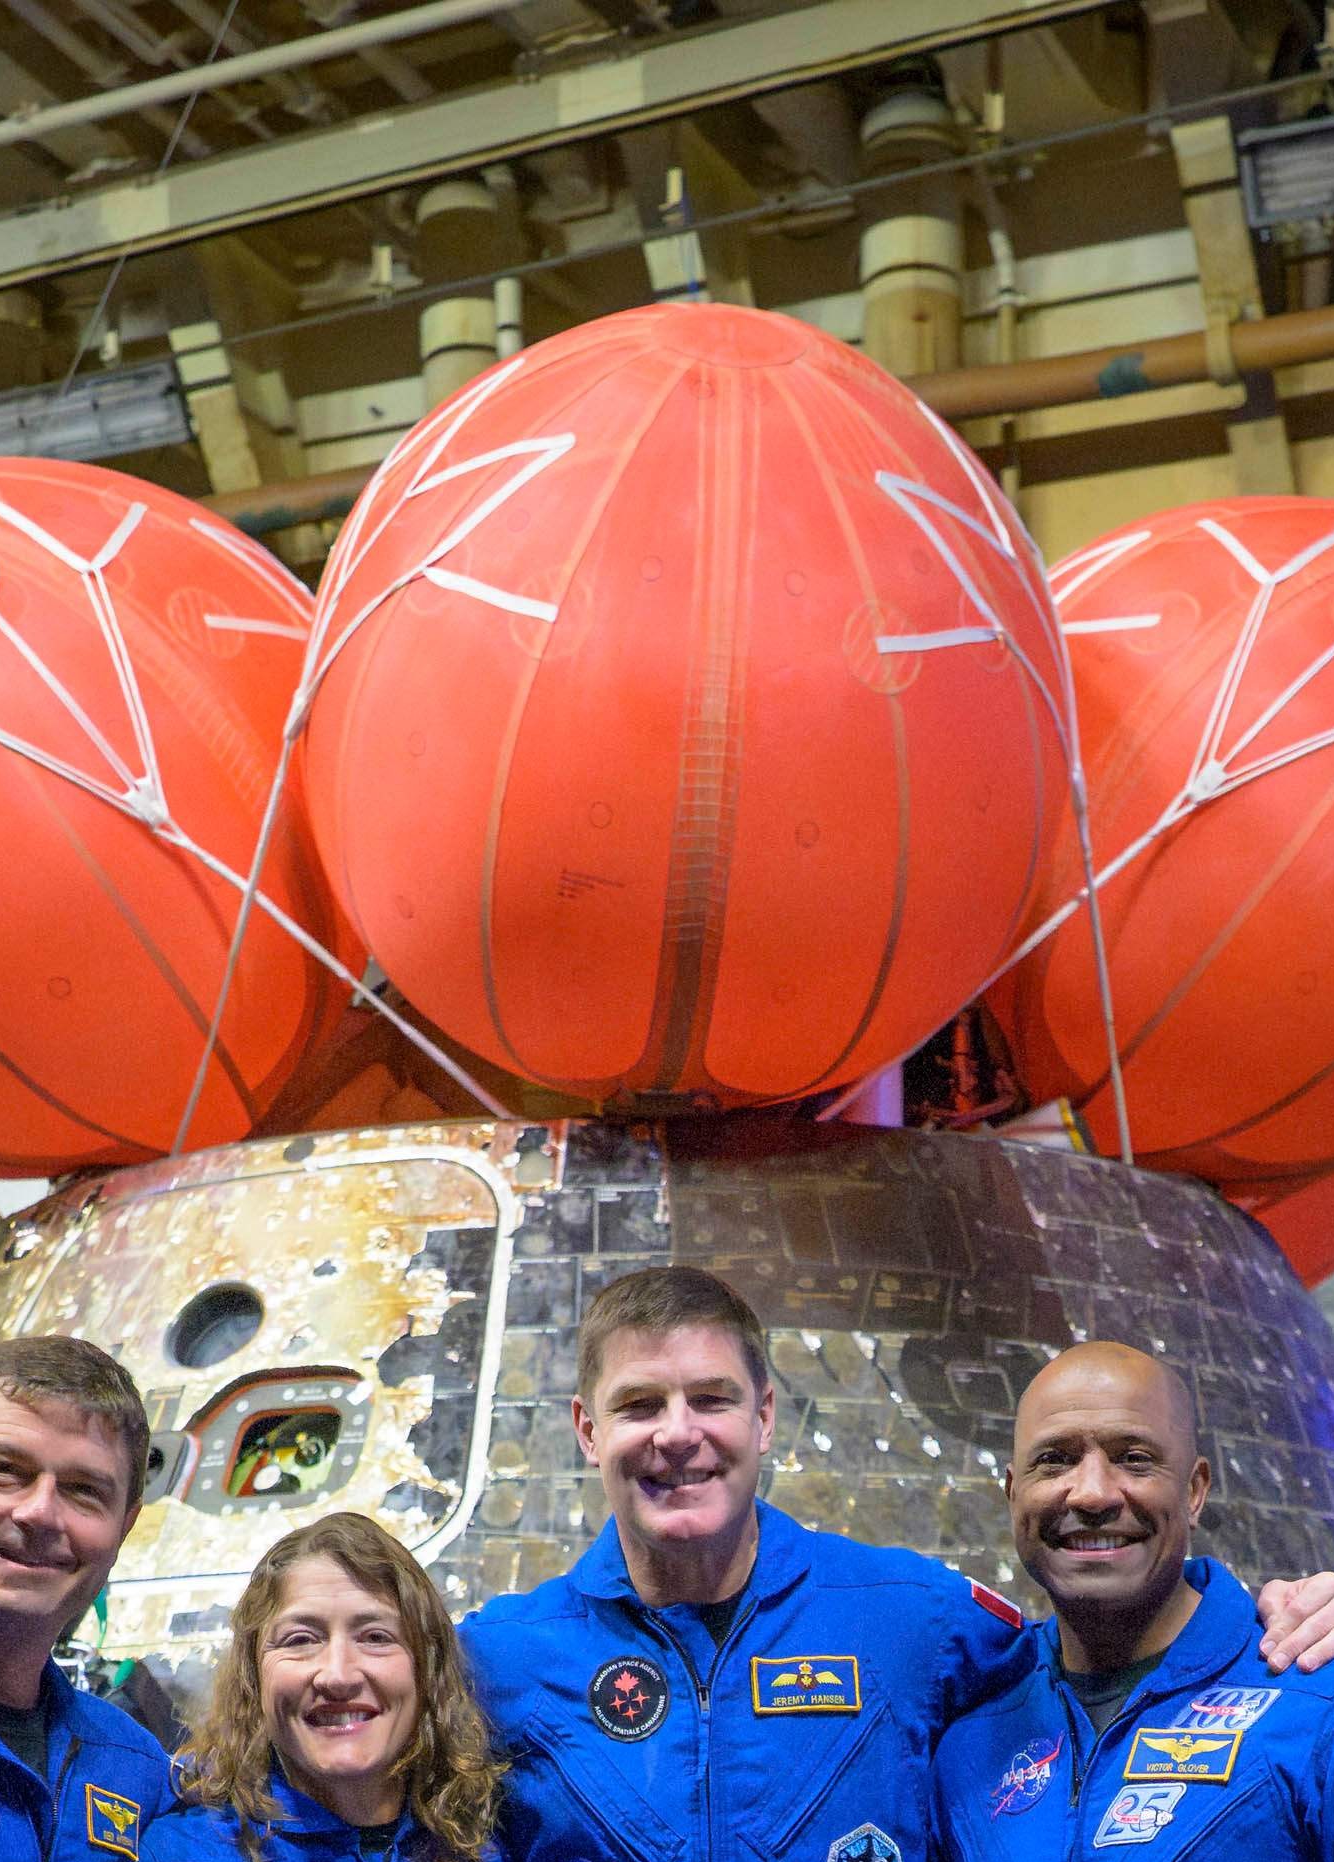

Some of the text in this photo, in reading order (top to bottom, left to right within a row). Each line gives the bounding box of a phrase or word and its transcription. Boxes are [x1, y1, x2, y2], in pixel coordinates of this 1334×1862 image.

[593, 1660, 661, 1692] CANADIAN SPACE AGENCY
[593, 1705, 613, 1730] AGENCE
[640, 1694, 666, 1731] CANADIENNE
[771, 1694, 846, 1707] JEREMY HANSEN
[1002, 1762, 1051, 1790] NASA
[1146, 1762, 1210, 1774] VICTOR GLOVER
